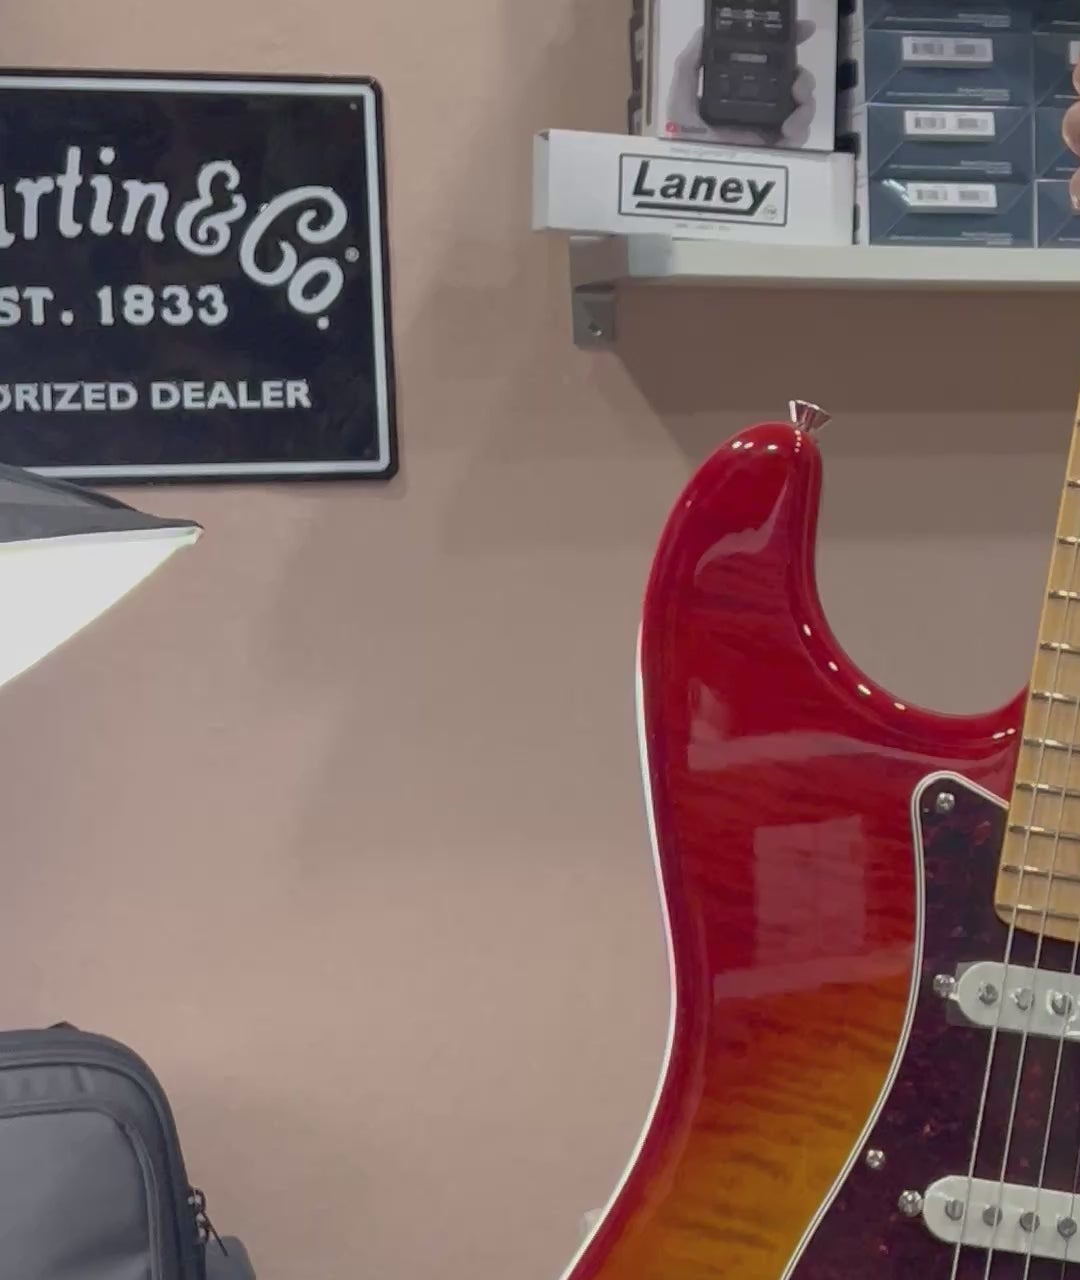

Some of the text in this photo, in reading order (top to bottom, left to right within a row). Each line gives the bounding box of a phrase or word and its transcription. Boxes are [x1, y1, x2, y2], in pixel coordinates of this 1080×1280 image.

[632, 159, 776, 216] Laney
[97, 284, 229, 326] 1833
[151, 377, 312, 410] DEALER
